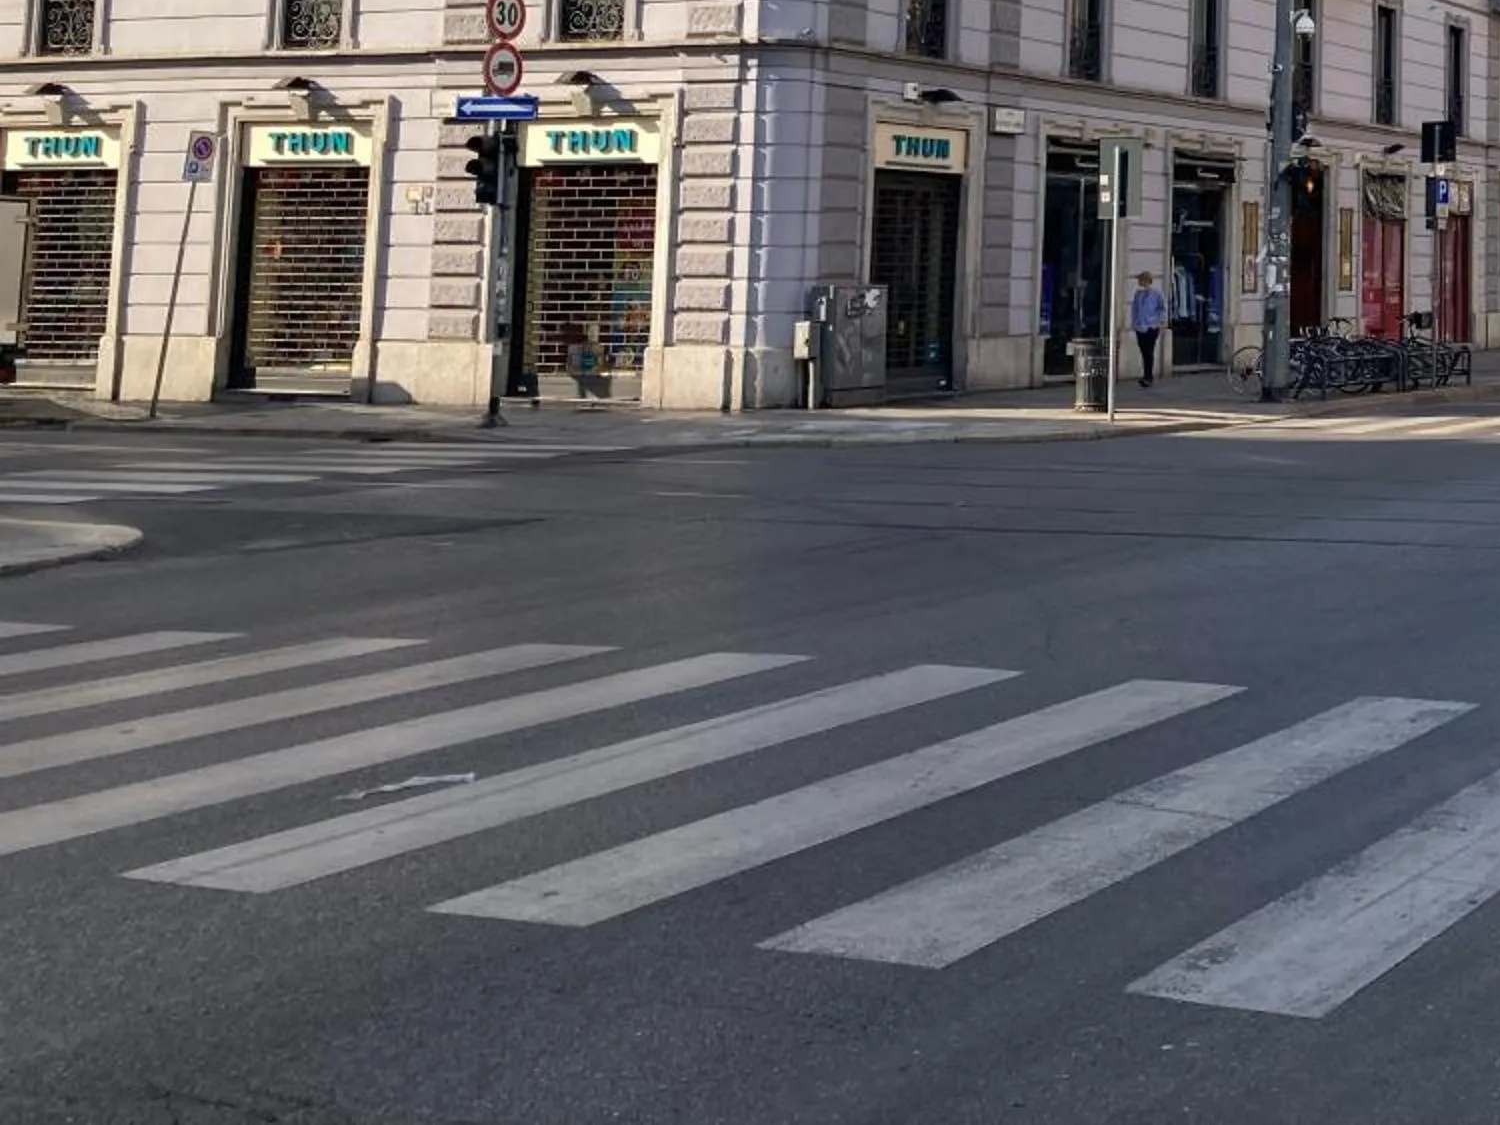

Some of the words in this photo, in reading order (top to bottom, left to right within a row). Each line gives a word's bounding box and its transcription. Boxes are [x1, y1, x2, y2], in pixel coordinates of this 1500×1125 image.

[495, 1, 519, 27] 30
[24, 136, 102, 158] THUN
[268, 131, 355, 155] THUN
[546, 129, 637, 154] THUN
[892, 134, 950, 160] THUN
[1439, 180, 1447, 200] P
